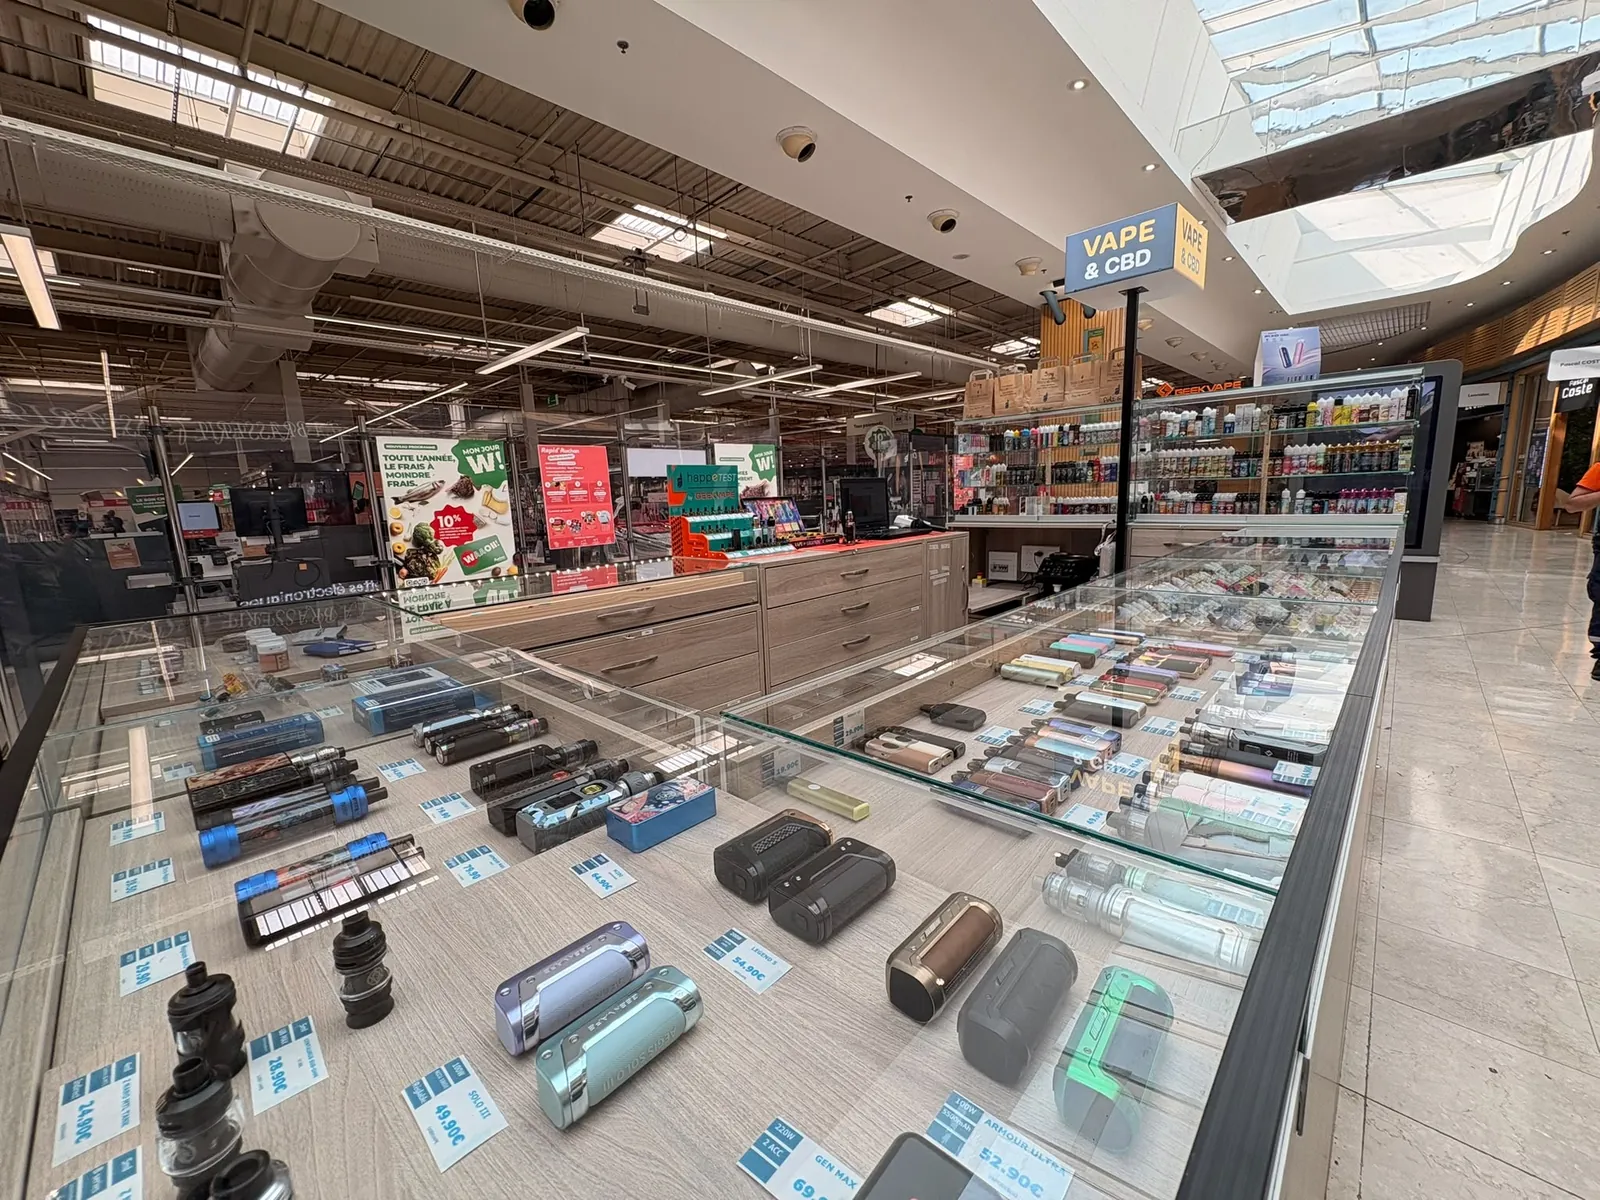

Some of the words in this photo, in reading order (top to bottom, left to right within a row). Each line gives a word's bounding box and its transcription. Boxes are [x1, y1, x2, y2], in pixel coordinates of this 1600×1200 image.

[1083, 219, 1156, 257] VAPE
[1182, 217, 1203, 253] VAPE
[1084, 262, 1099, 280] &
[1104, 248, 1151, 275] CBD
[1181, 248, 1187, 265] &
[1187, 255, 1200, 276] CBD
[1174, 381, 1242, 396] GEEKVAPE
[1562, 383, 1593, 399] Coste
[416, 453, 456, 463] L'ANNÉE,
[481, 444, 500, 452] JOUR
[428, 462, 435, 470] À
[466, 451, 505, 475] W!
[756, 454, 775, 471] W!
[437, 514, 461, 528] 10%
[462, 864, 481, 880] 79.90
[751, 946, 773, 962] LEGEND
[135, 961, 151, 986] 29.90
[732, 955, 766, 982] 54.90€
[646, 1025, 679, 1057] AEGIS
[268, 1055, 289, 1094] 28.90€
[614, 1051, 648, 1081] SOLO
[602, 1076, 616, 1093] III
[467, 1089, 485, 1110] SOLO
[478, 1106, 492, 1120] III
[954, 1097, 978, 1116] 100W
[76, 1099, 94, 1144] 24.90€
[432, 1102, 467, 1147] 49.90€
[774, 1122, 796, 1141] 220W
[940, 1108, 973, 1133] 5500mAh
[762, 1138, 770, 1146] 2
[767, 1142, 784, 1158] ACC
[983, 1117, 1031, 1152] ARMOUR
[1029, 1147, 1068, 1177] ULTRA
[815, 1154, 835, 1172] GEN
[834, 1170, 858, 1189] MAX
[977, 1146, 1045, 1199] 52.90€
